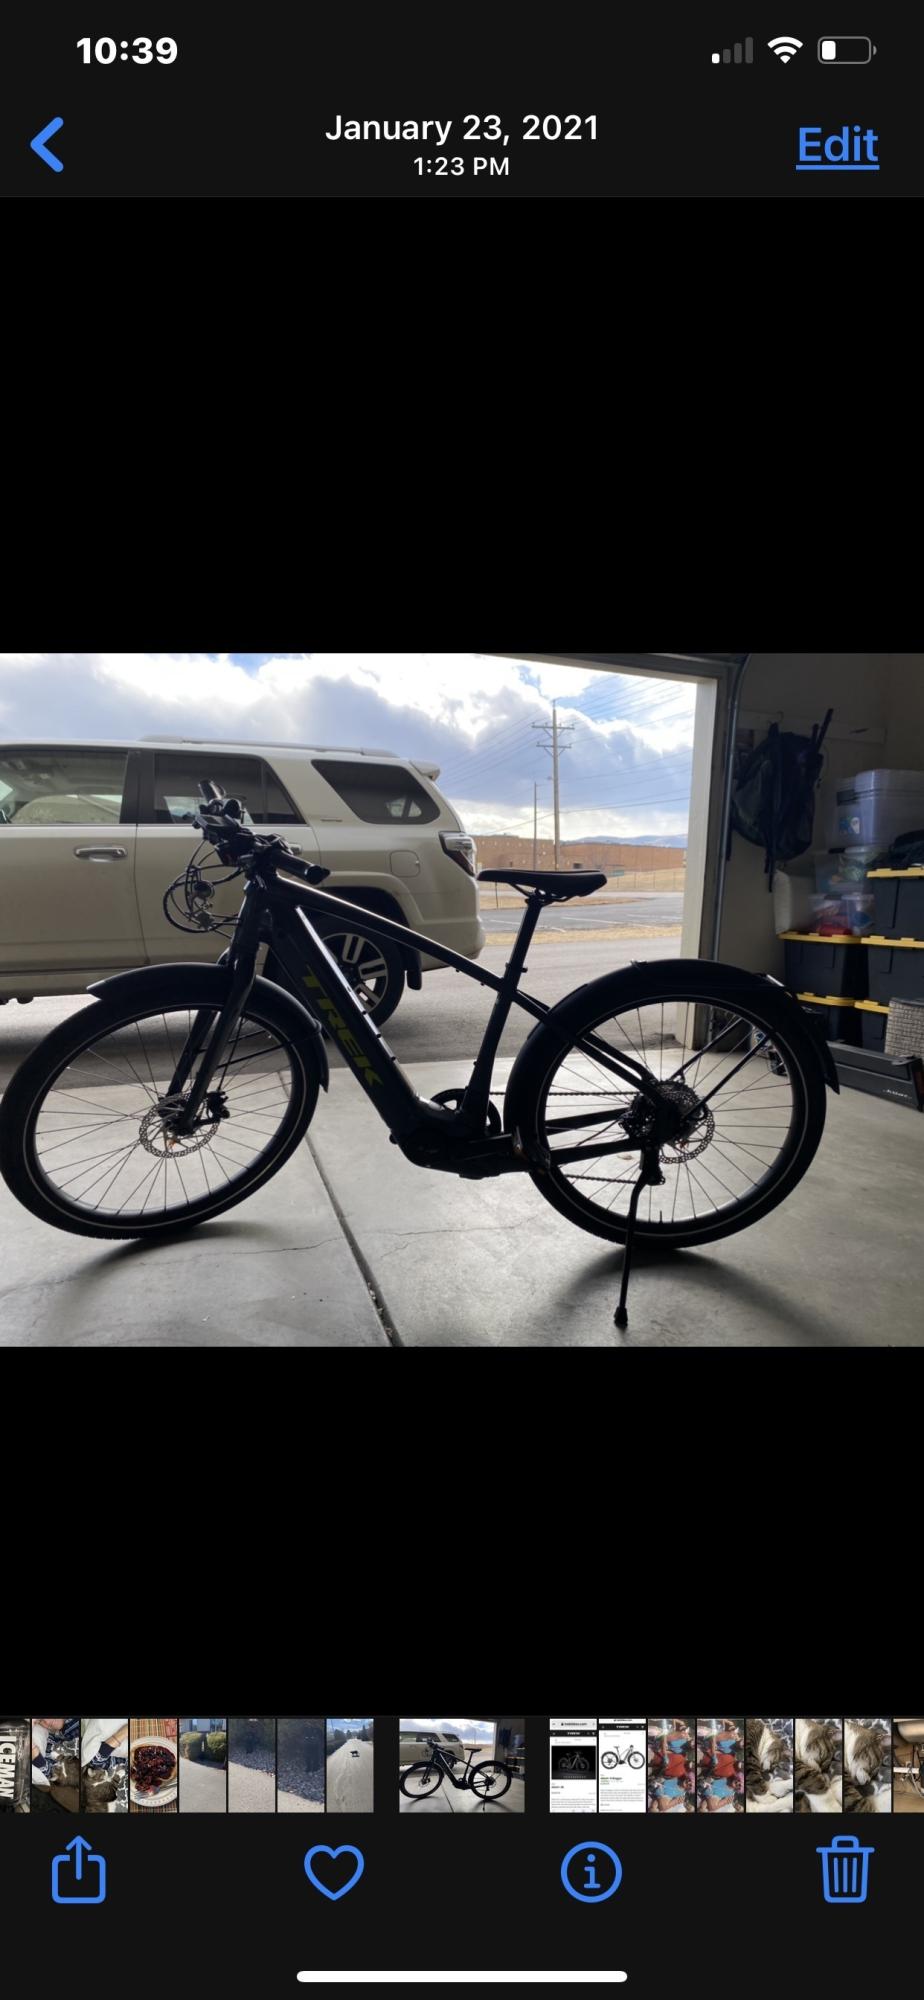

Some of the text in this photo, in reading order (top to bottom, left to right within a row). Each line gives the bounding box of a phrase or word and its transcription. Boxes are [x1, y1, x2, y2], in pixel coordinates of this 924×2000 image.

[76, 36, 178, 65] 10:39
[324, 113, 597, 147] January 23, 2021
[796, 125, 880, 163] Edit
[413, 156, 510, 177] 1:23 PM
[303, 965, 383, 1086] TREK
[0, 1736, 17, 1799] ICEMAN
